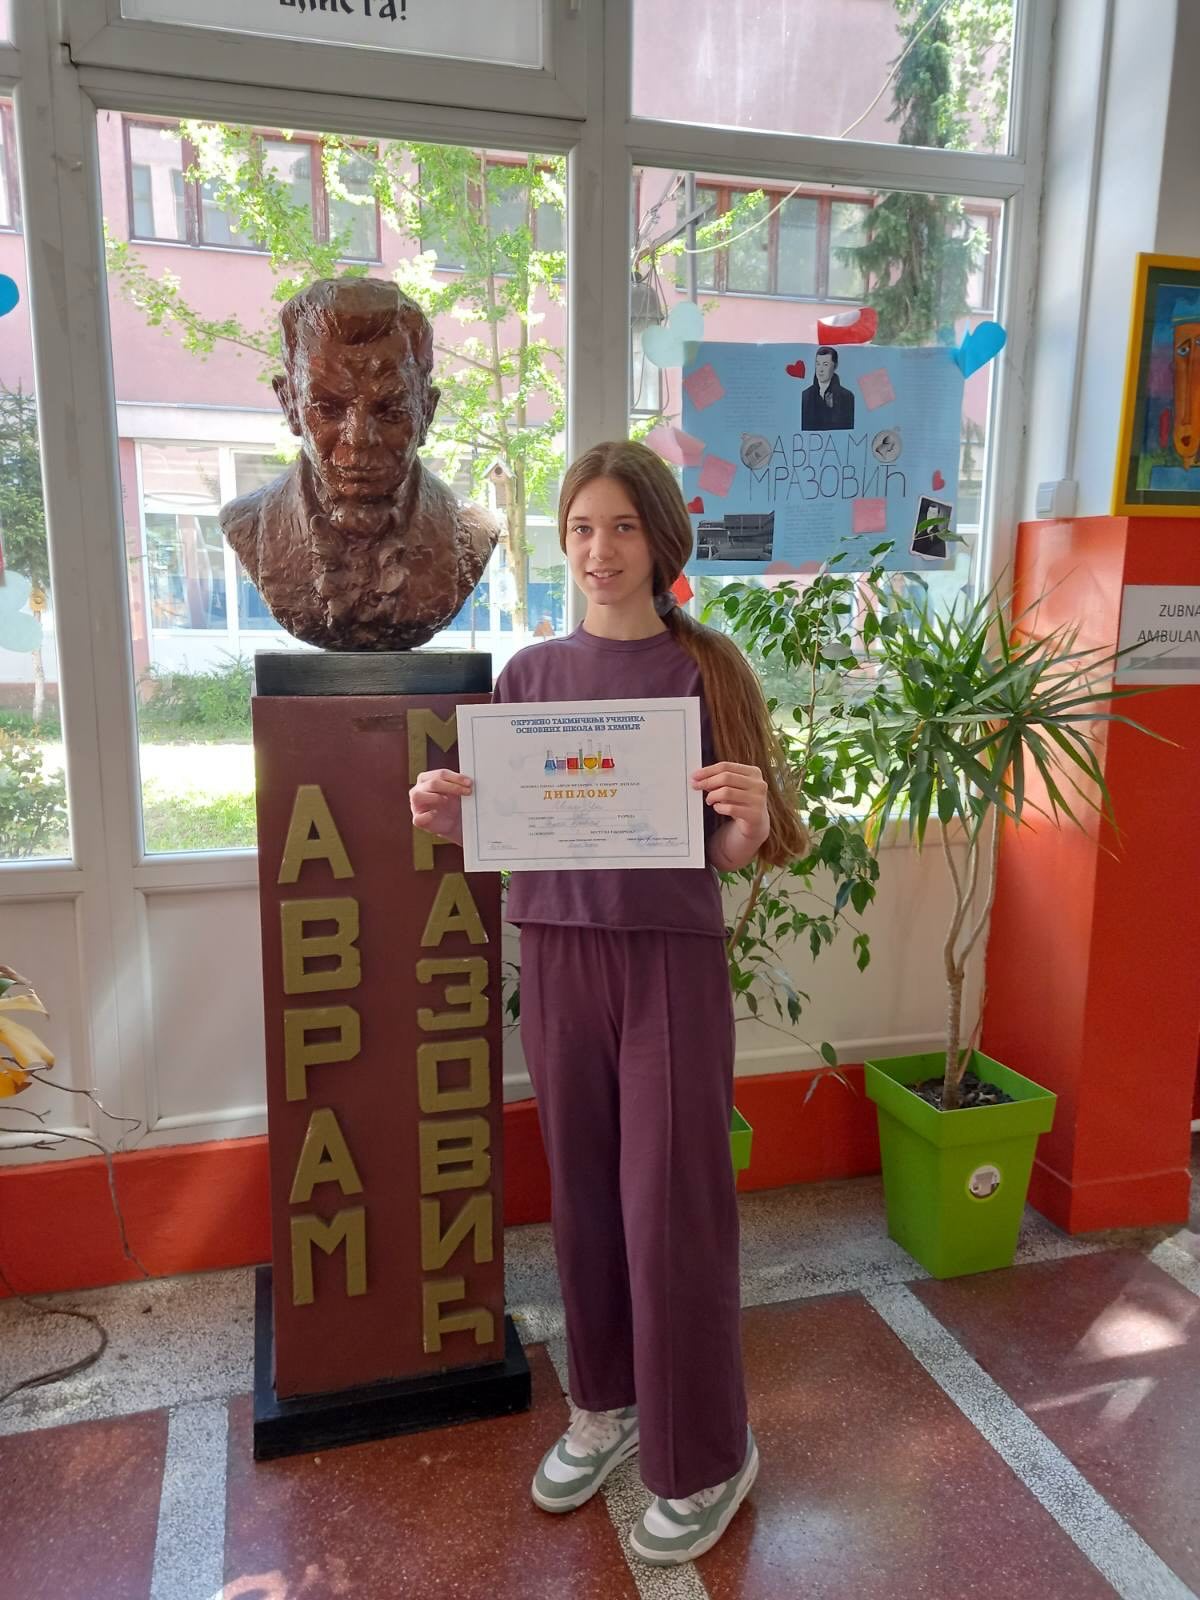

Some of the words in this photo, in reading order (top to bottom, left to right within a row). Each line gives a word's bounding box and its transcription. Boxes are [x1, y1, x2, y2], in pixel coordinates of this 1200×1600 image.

[768, 432, 868, 467] АВРАМ
[750, 465, 906, 501] МРАЗОВИЋ
[511, 718, 550, 726] ОКРУЖНО
[606, 715, 645, 723] УЧЕНИКА
[516, 726, 560, 734] ОСНОВНИХ
[607, 723, 640, 731] ХЕМИЈЕ
[543, 788, 618, 800] ДИПЛОМУ
[278, 784, 367, 1306] АВРАМ
